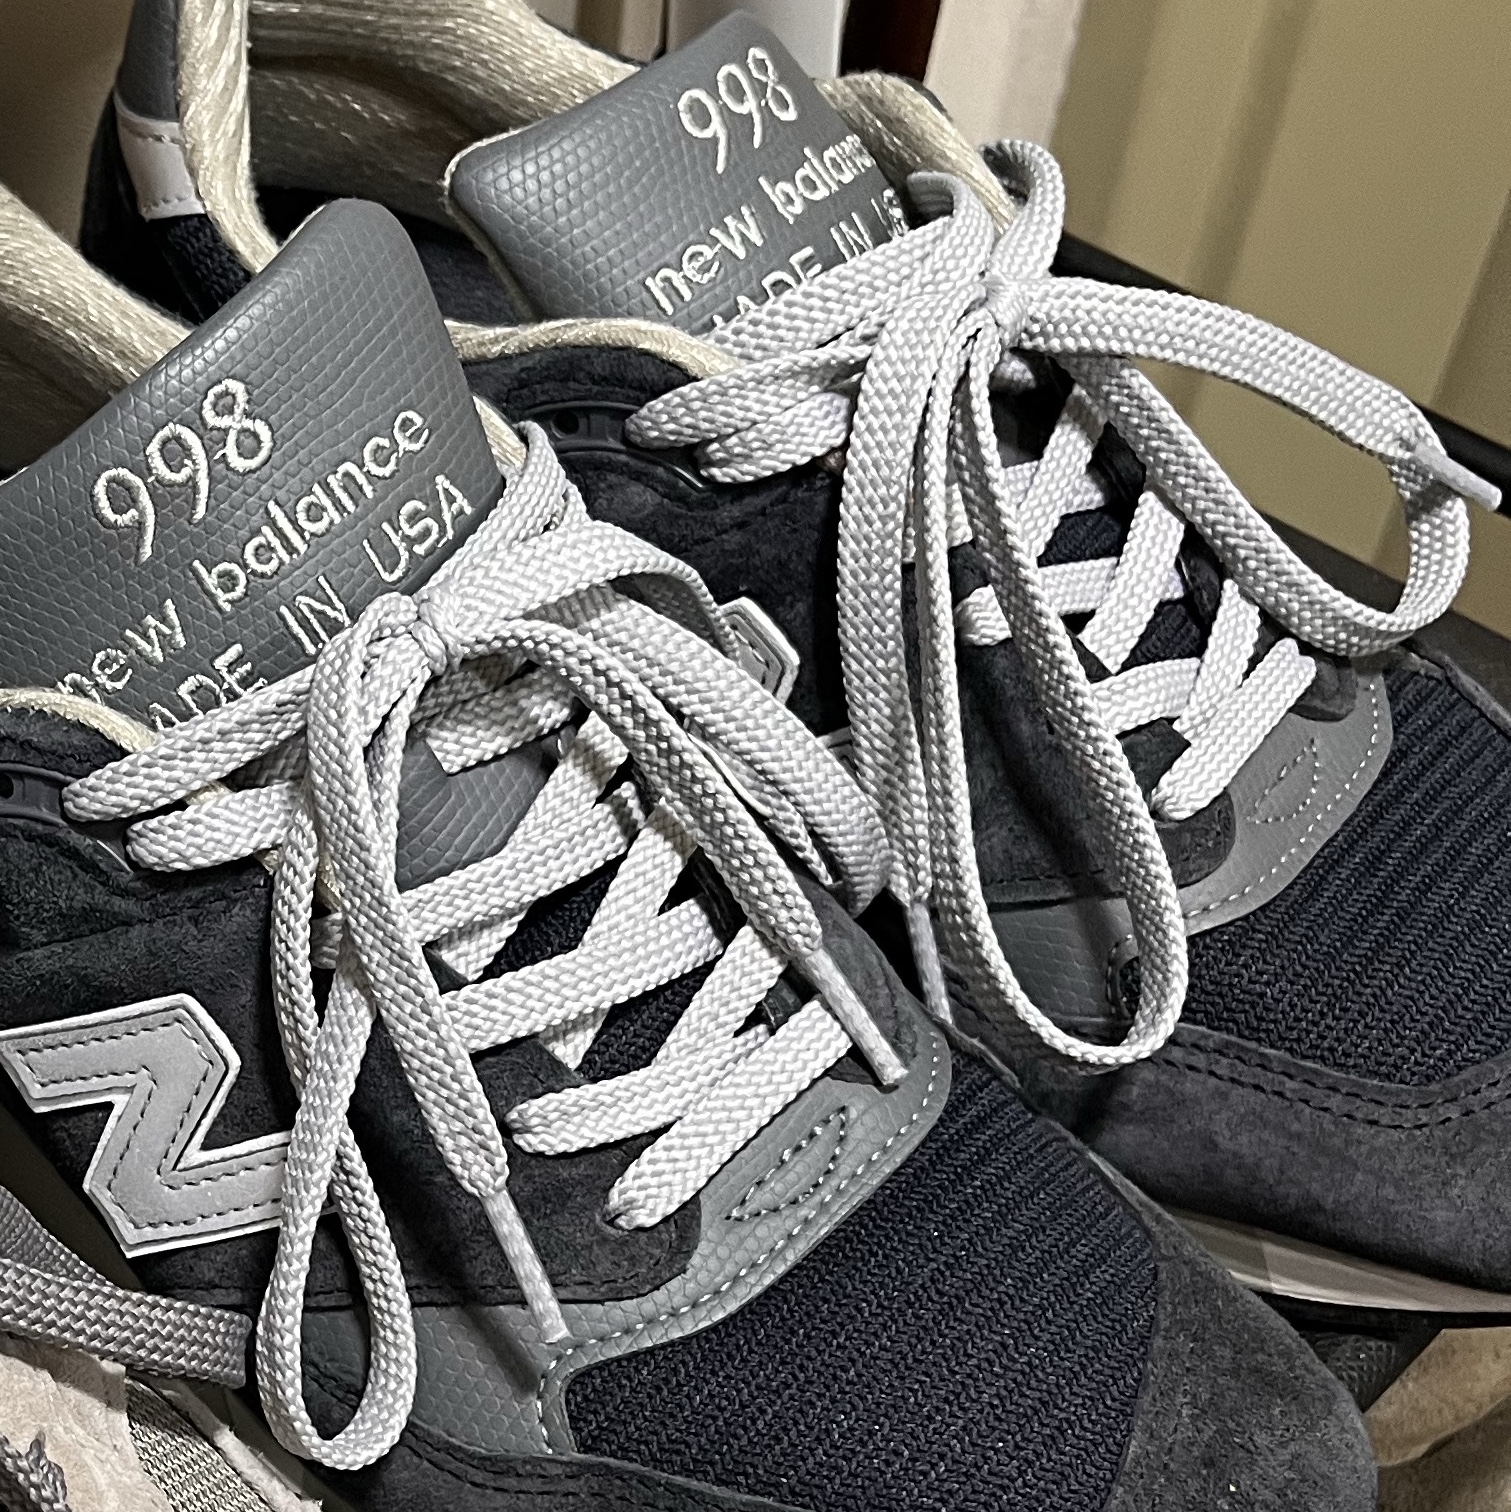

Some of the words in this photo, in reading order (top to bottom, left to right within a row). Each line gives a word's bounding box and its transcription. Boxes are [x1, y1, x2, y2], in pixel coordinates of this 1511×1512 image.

[678, 46, 798, 175] 998
[645, 204, 765, 316] new
[56, 598, 187, 705] new
[192, 409, 431, 612] balance
[91, 378, 275, 565] 998
[280, 575, 353, 655] IN
[363, 474, 473, 584] USA
